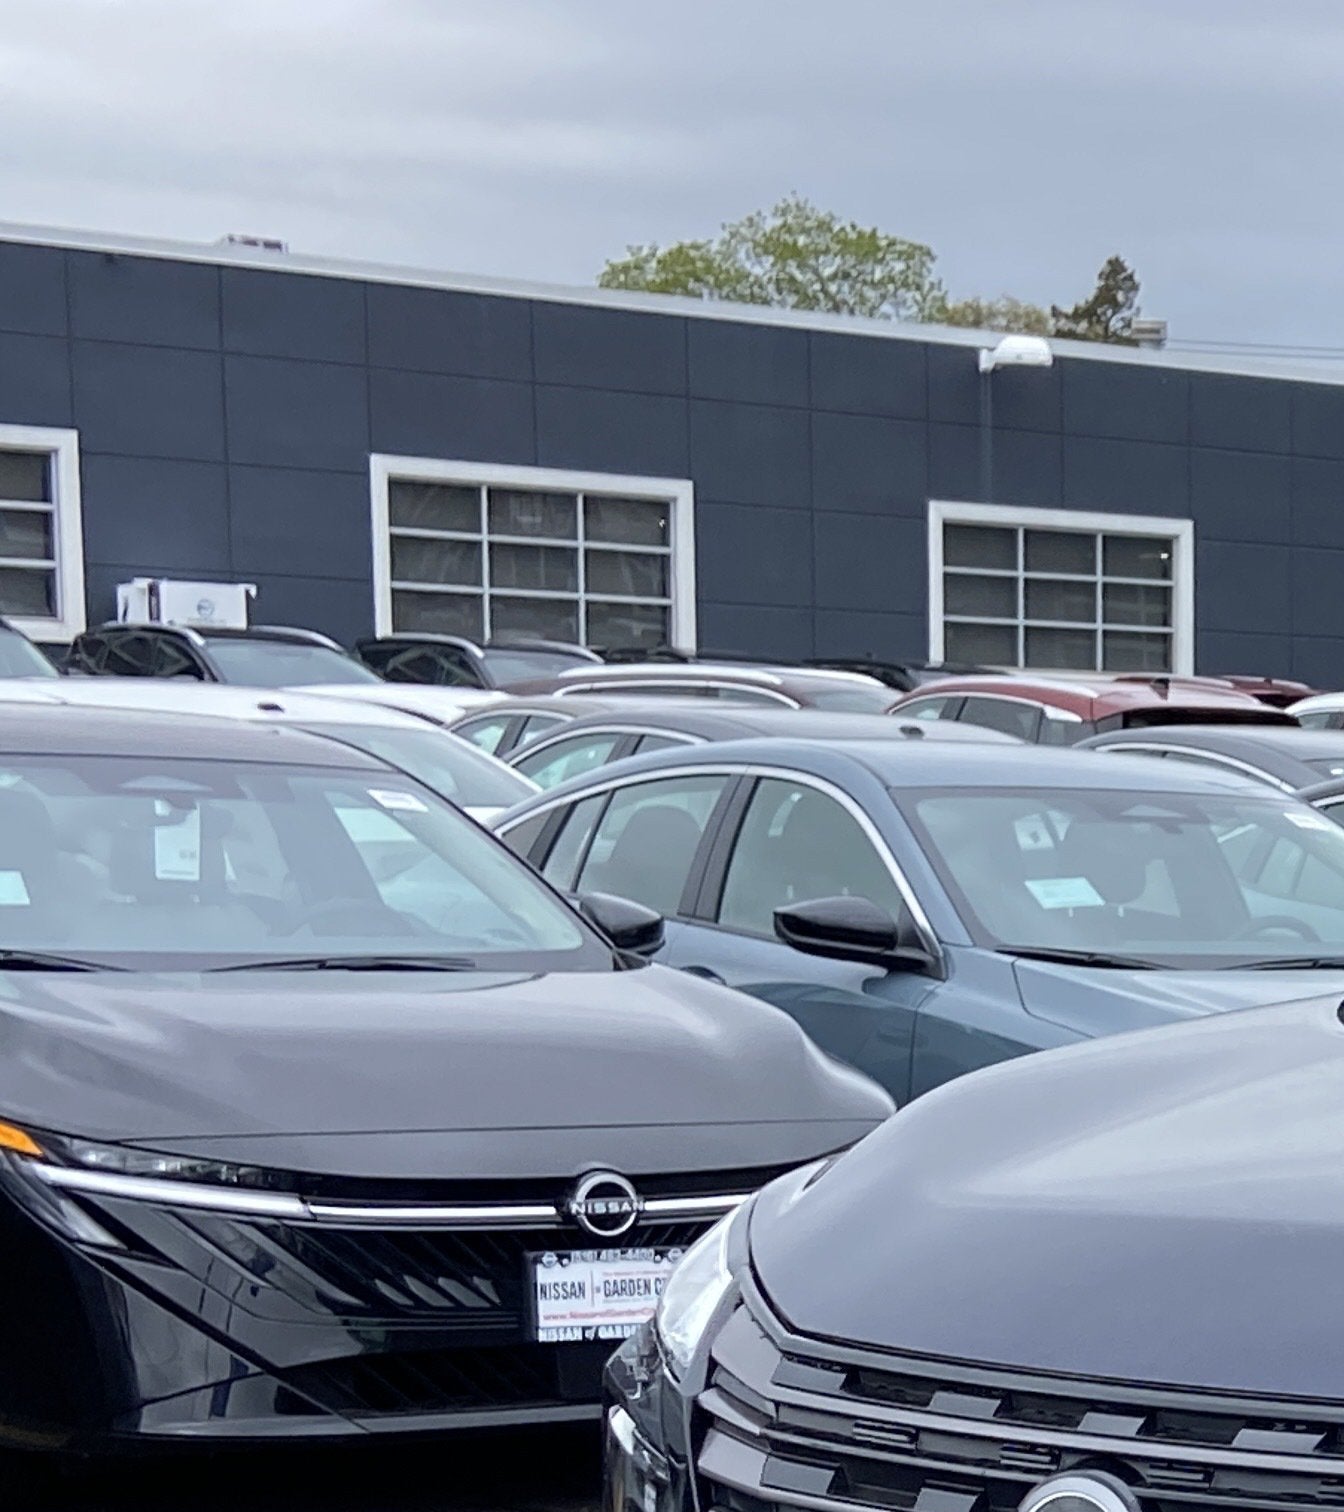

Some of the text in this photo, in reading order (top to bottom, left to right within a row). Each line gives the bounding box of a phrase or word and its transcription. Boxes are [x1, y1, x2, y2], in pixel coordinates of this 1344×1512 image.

[570, 1200, 644, 1215] NISSAN
[539, 1281, 586, 1301] NISSAN
[603, 1278, 651, 1297] GARDEN
